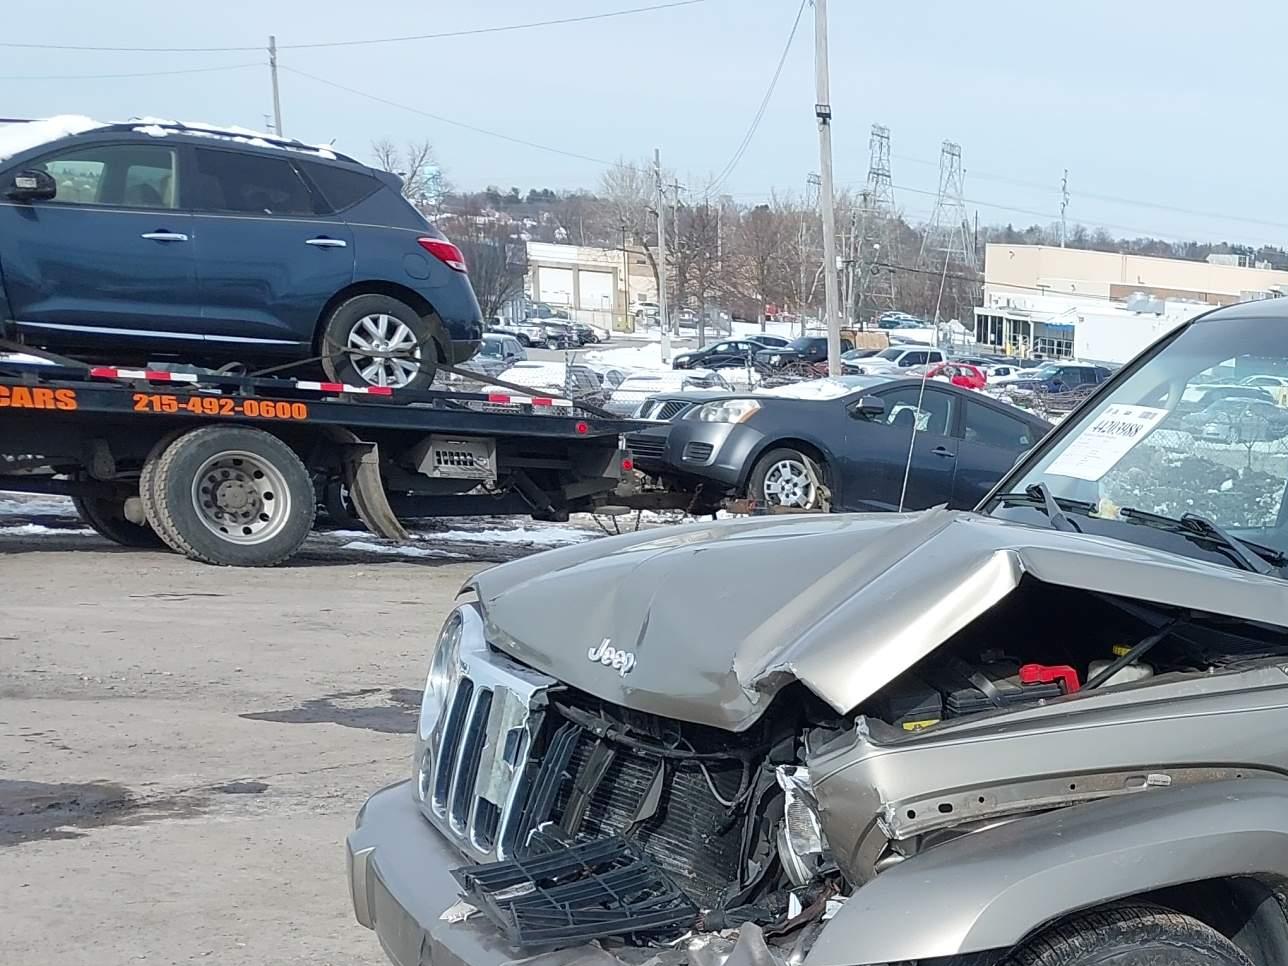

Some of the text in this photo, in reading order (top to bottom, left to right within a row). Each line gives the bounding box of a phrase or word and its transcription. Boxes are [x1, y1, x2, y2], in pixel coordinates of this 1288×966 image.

[133, 393, 308, 420] 215-492-0600
[1092, 419, 1144, 438] 44203988
[588, 638, 636, 677] Jeep
